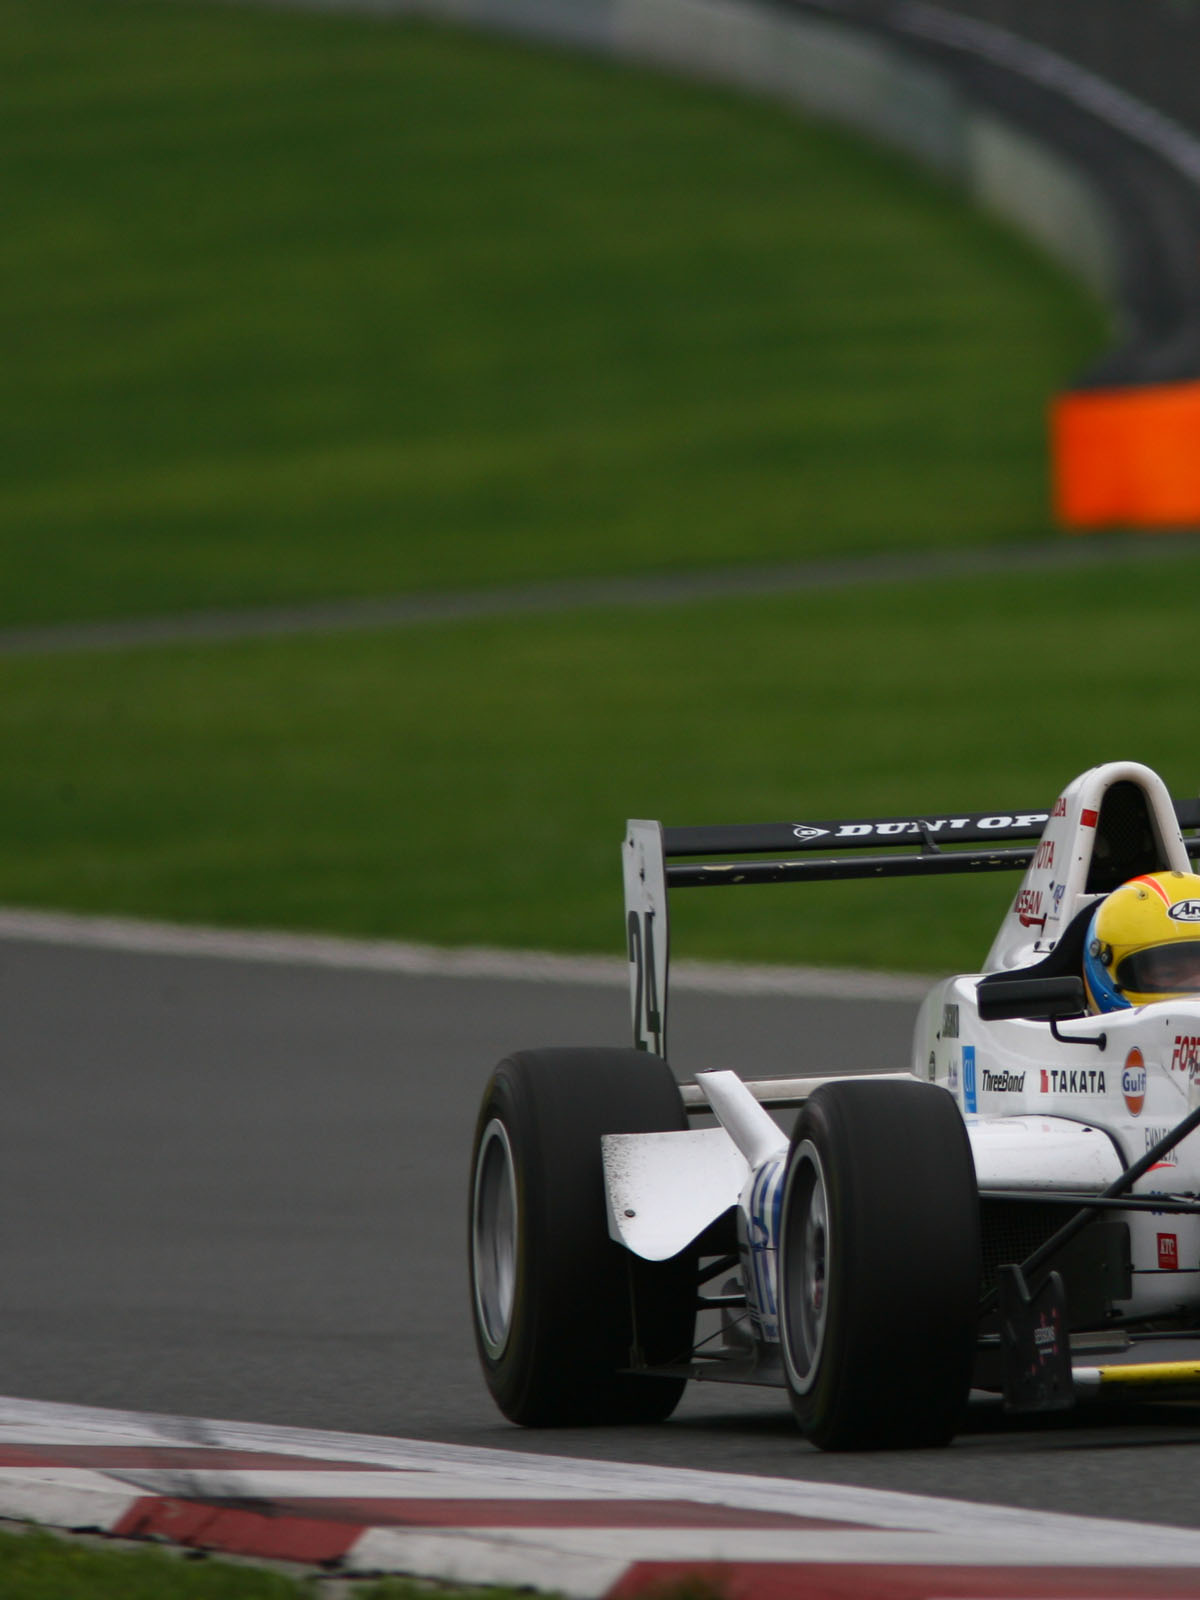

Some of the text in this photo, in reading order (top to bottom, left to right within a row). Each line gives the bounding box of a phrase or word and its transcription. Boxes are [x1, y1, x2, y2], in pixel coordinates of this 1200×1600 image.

[628, 910, 661, 1056] 24
[982, 1069, 1026, 1092] ThreeBond
[1050, 1070, 1106, 1093] TAKATA
[1122, 1072, 1146, 1092] Gulf
